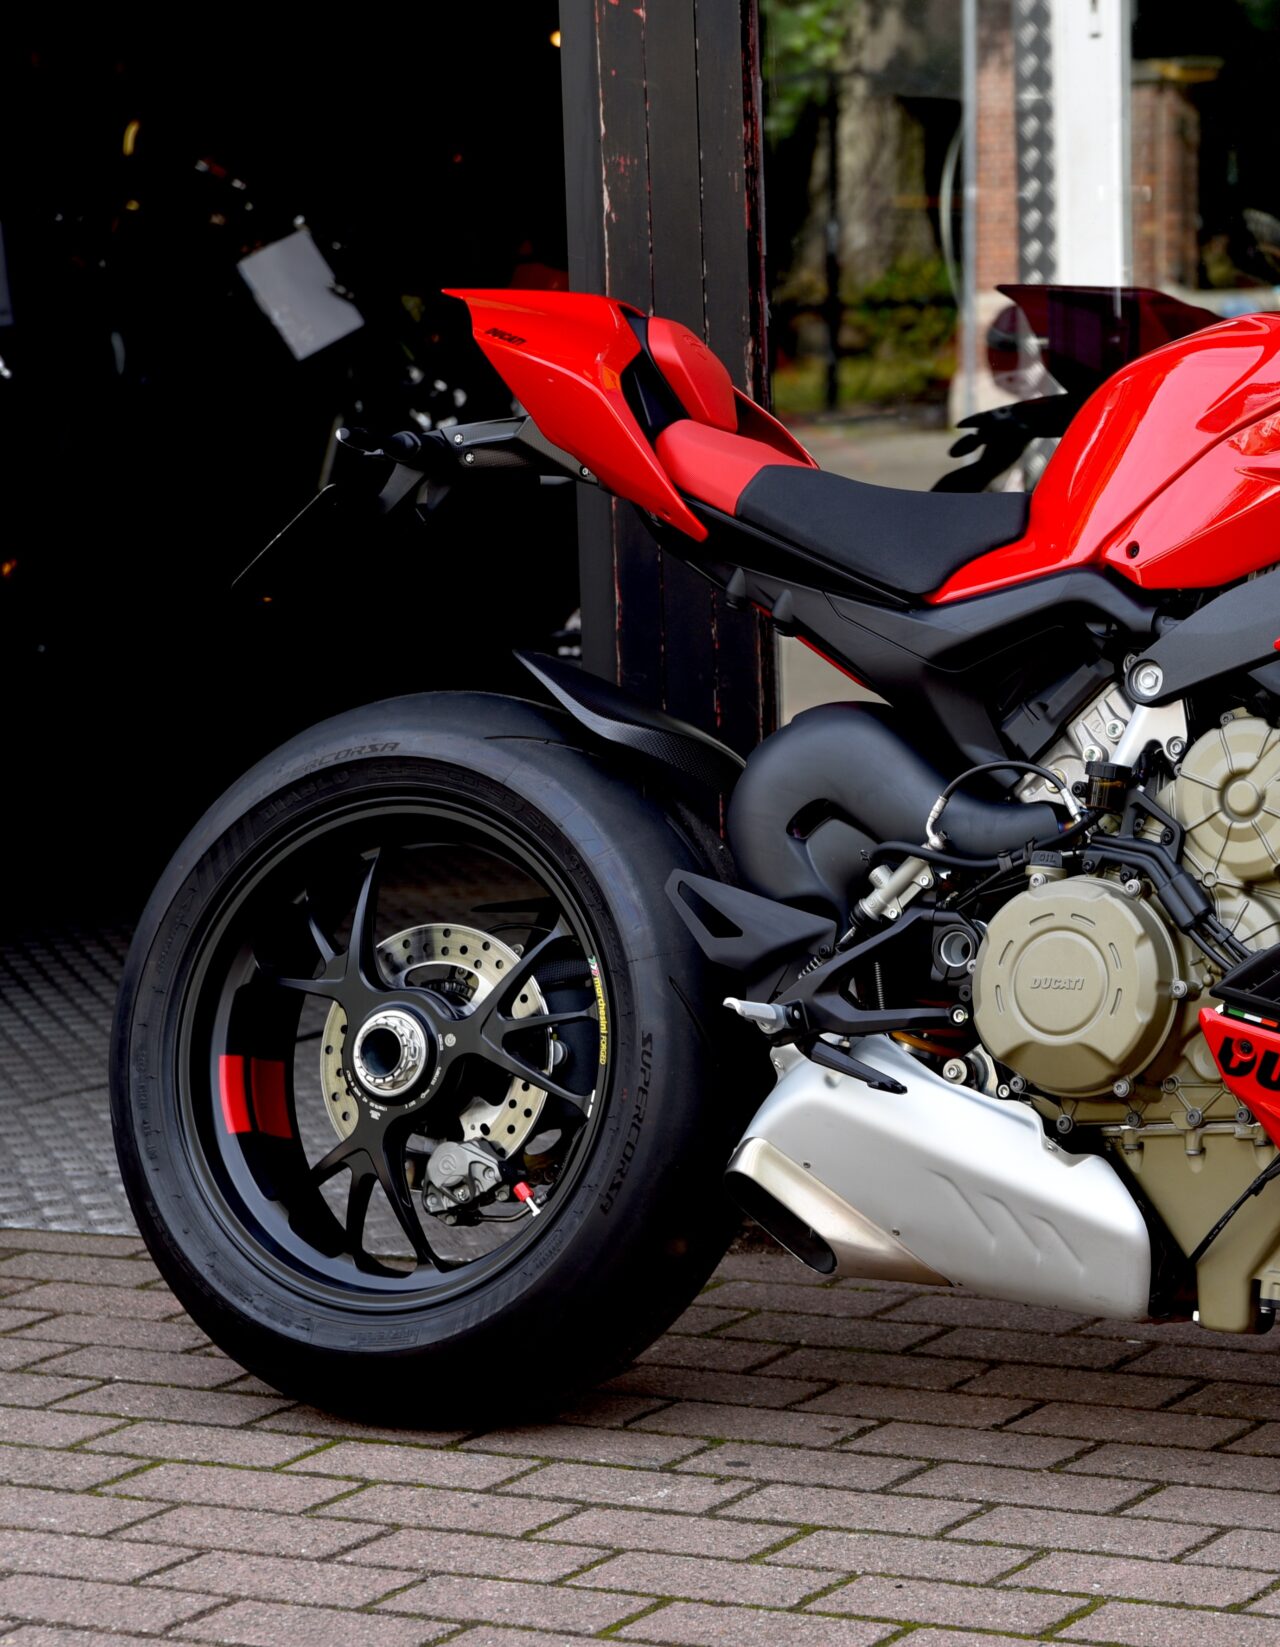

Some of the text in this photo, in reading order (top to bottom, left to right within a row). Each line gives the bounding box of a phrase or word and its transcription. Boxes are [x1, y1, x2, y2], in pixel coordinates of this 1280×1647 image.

[593, 977, 608, 1034] marchesini
[1030, 976, 1085, 991] DUCATI
[599, 1031, 654, 1216] SUPERCORSA
